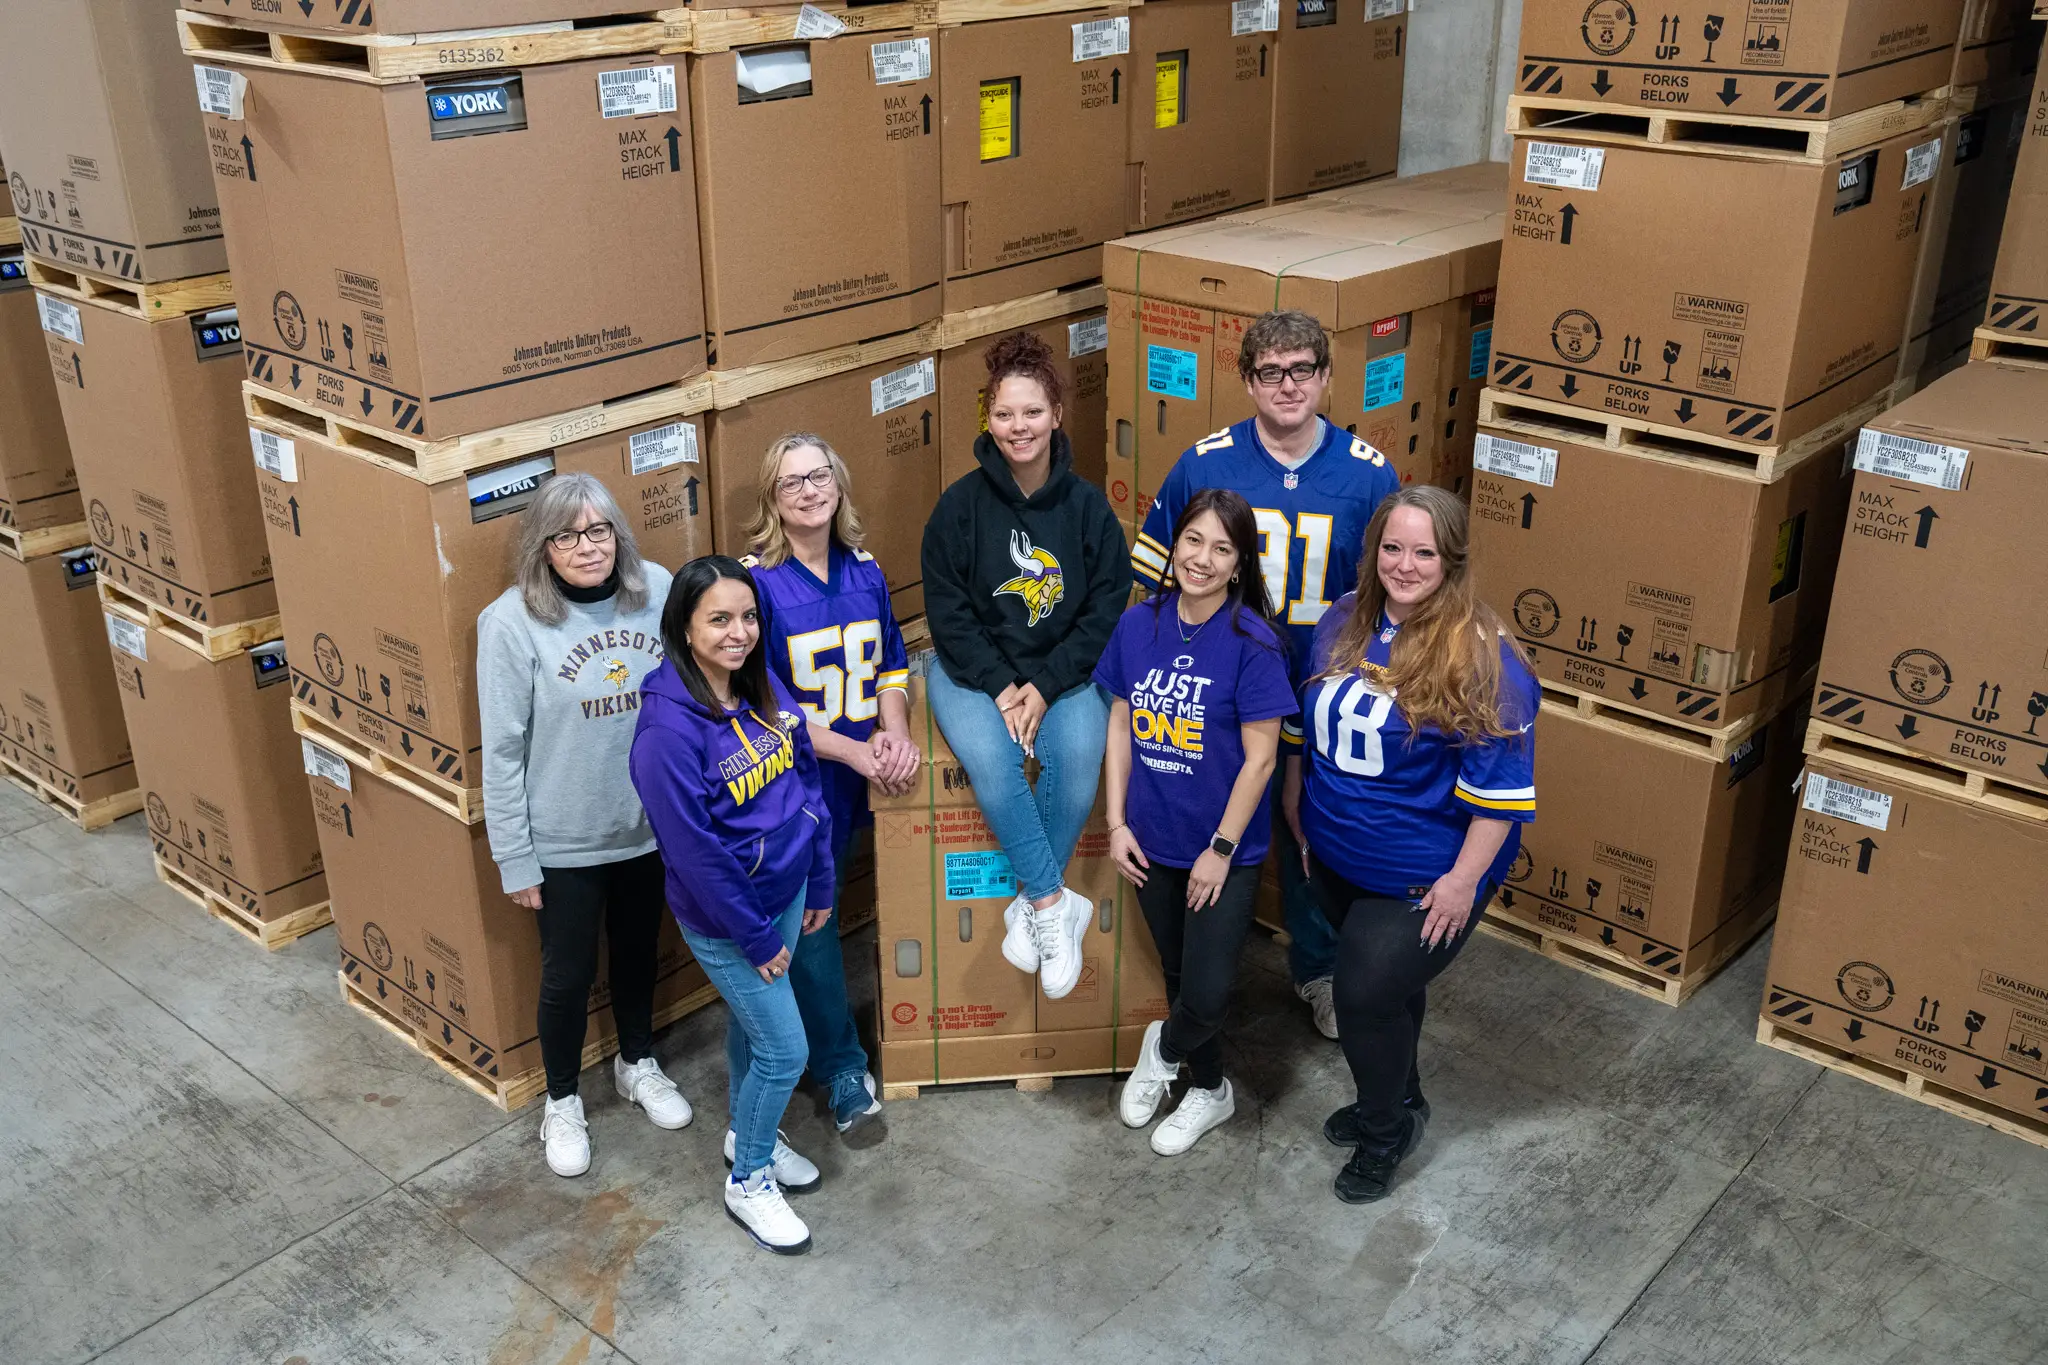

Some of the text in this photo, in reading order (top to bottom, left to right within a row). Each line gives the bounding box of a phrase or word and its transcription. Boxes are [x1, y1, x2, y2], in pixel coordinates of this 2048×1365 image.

[1303, 0, 1325, 12] YORK
[1594, 18, 1615, 26] Controls
[439, 47, 505, 64] 6135362
[1655, 45, 1680, 60] UP
[1643, 73, 1689, 87] FORKS
[1081, 84, 1108, 96] STACK
[1640, 89, 1689, 103] BELOW
[450, 87, 503, 115] YORK
[884, 96, 907, 110] MAX
[1081, 96, 1109, 109] HEIGHT
[885, 111, 918, 126] STACK
[209, 126, 229, 143] MAX
[618, 129, 647, 145] MAX
[886, 126, 920, 141] HEIGHT
[213, 144, 241, 162] STACK
[620, 145, 663, 163] STACK
[215, 162, 245, 179] HEIGHT
[622, 161, 666, 181] HEIGHT
[1515, 193, 1543, 209] MAX
[1514, 209, 1555, 227] STACK
[183, 222, 221, 234] 5005 York
[1512, 224, 1556, 242] HEIGHT
[63, 237, 84, 251] FORKS
[65, 251, 87, 265] BELOW
[343, 274, 378, 291] WARNING
[793, 271, 889, 302] Johnson Controls Products
[783, 304, 798, 314] 5005
[800, 301, 813, 309] York
[885, 282, 899, 291] USA
[1688, 296, 1745, 314] WARNING
[363, 313, 384, 325] CAUTION
[1151, 303, 1160, 313] Not
[1170, 305, 1177, 317] By
[1190, 309, 1201, 321] Cap
[1376, 319, 1397, 334] bryant
[1560, 323, 1579, 332] Johnson
[1563, 329, 1583, 337] Controls
[514, 324, 632, 362] Johnson Controls Unitary Products
[1706, 331, 1741, 343] CAUTION
[320, 347, 335, 363] UP
[502, 337, 643, 376] 5005 York Drive, Norman USA
[1619, 360, 1642, 375] UP
[317, 373, 344, 391] FORKS
[316, 389, 344, 407] BELOW
[1607, 383, 1650, 401] FORKS
[1604, 398, 1650, 415] BELOW
[550, 413, 607, 443] 6135362
[885, 416, 907, 430] MAX
[886, 426, 918, 444] STACK
[886, 439, 920, 458] HEIGHT
[1940, 446, 1947, 454] 5
[261, 481, 278, 498] MAX
[641, 483, 668, 500] MAX
[1478, 480, 1504, 495] MAX
[139, 495, 166, 512] WARNING
[264, 496, 288, 517] STACK
[643, 496, 682, 516] STACK
[1477, 493, 1516, 512] STACK
[1858, 491, 1894, 509] MAX
[266, 514, 291, 532] HEIGHT
[644, 509, 685, 531] HEIGHT
[1475, 507, 1517, 526] HEIGHT
[1856, 507, 1909, 528] STACK
[1853, 523, 1909, 544] HEIGHT
[1251, 507, 1334, 625] 91
[1640, 586, 1691, 606] WARNING
[1657, 619, 1688, 632] CAUTION
[382, 633, 419, 655] WARNING
[1577, 638, 1598, 653] UP
[401, 667, 424, 681] CAUTION
[787, 619, 882, 728] 58
[1566, 658, 1606, 678] FORKS
[1902, 661, 1925, 672] Johnson
[1905, 667, 1928, 679] Controls
[1134, 668, 1211, 703] JUST
[1564, 670, 1606, 689] BELOW
[359, 688, 372, 704] UP
[581, 690, 641, 719] VIKIN
[1131, 691, 1206, 722] GIVE ME
[1971, 707, 2000, 724] UP
[357, 709, 384, 731] FORKS
[1314, 670, 1398, 777] 18
[359, 723, 386, 745] BELOW
[1132, 708, 1204, 753] ONE
[1954, 729, 2008, 752] FORKS
[1162, 745, 1184, 757] SINCE
[1184, 751, 1203, 761] 1969
[1949, 743, 2006, 767] BELOW
[1140, 753, 1194, 775] MINNESOTA
[312, 784, 330, 801] MAX
[942, 811, 981, 821] Not Lift By
[973, 822, 986, 831] Par
[1803, 818, 1837, 837] MAX
[972, 833, 985, 842] Por
[1801, 832, 1850, 855] STACK
[1606, 846, 1654, 868] WARNING
[1799, 845, 1852, 869] HEIGHT
[1623, 876, 1652, 891] CAUTION
[1550, 886, 1569, 900] UP
[1540, 903, 1577, 923] FORKS
[1538, 914, 1577, 933] BELOW
[430, 936, 460, 961] WARNING
[405, 977, 418, 992] UP
[1848, 970, 1869, 982] Johnson
[1850, 977, 1873, 989] Controls
[402, 995, 427, 1018] FORKS
[967, 1004, 992, 1013] Drop
[402, 1008, 428, 1030] BELOW
[943, 1014, 961, 1022] Pas
[1913, 1018, 1940, 1034] UP
[1898, 1036, 1947, 1061] FORKS
[1894, 1048, 1947, 1074] BELOW
